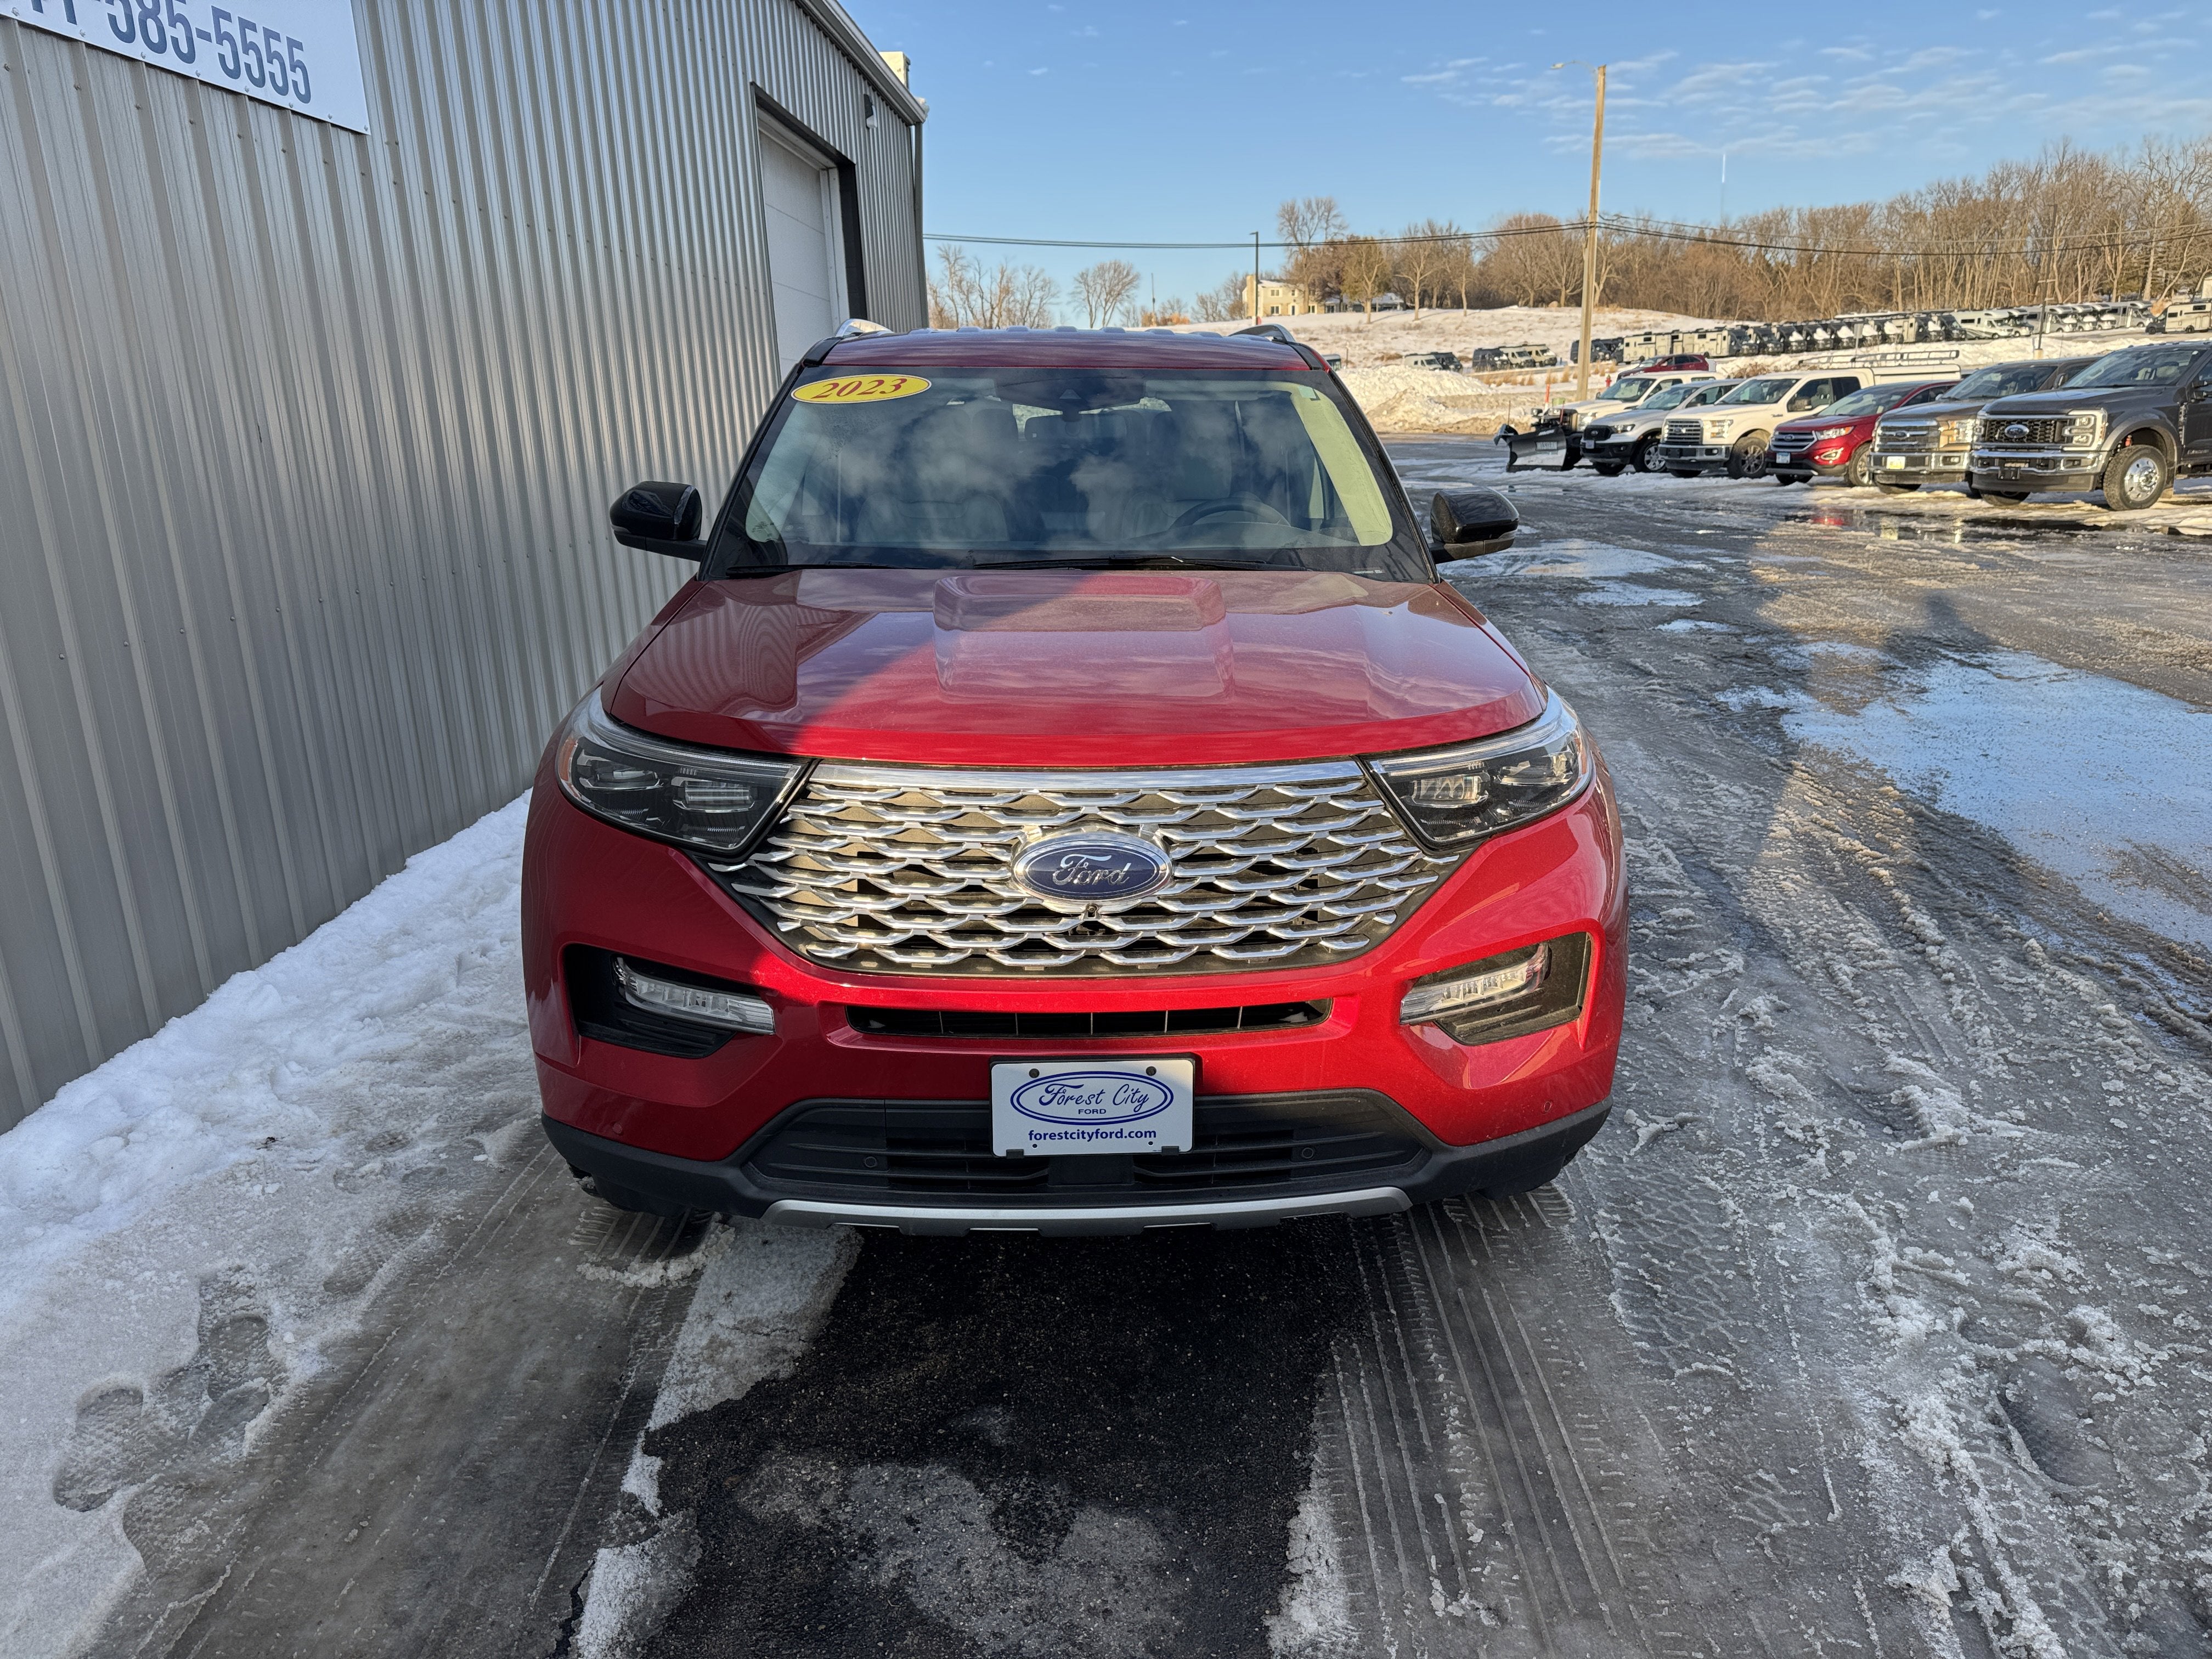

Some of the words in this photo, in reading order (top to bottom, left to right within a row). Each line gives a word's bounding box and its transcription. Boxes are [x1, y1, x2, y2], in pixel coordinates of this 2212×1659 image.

[32, 0, 311, 104] 585-5555
[810, 378, 908, 399] 2023
[1052, 854, 1132, 886] Ford
[1039, 1083, 1106, 1106] Forest
[1112, 1084, 1150, 1113] City
[1028, 1128, 1157, 1142] forestcityford.com
